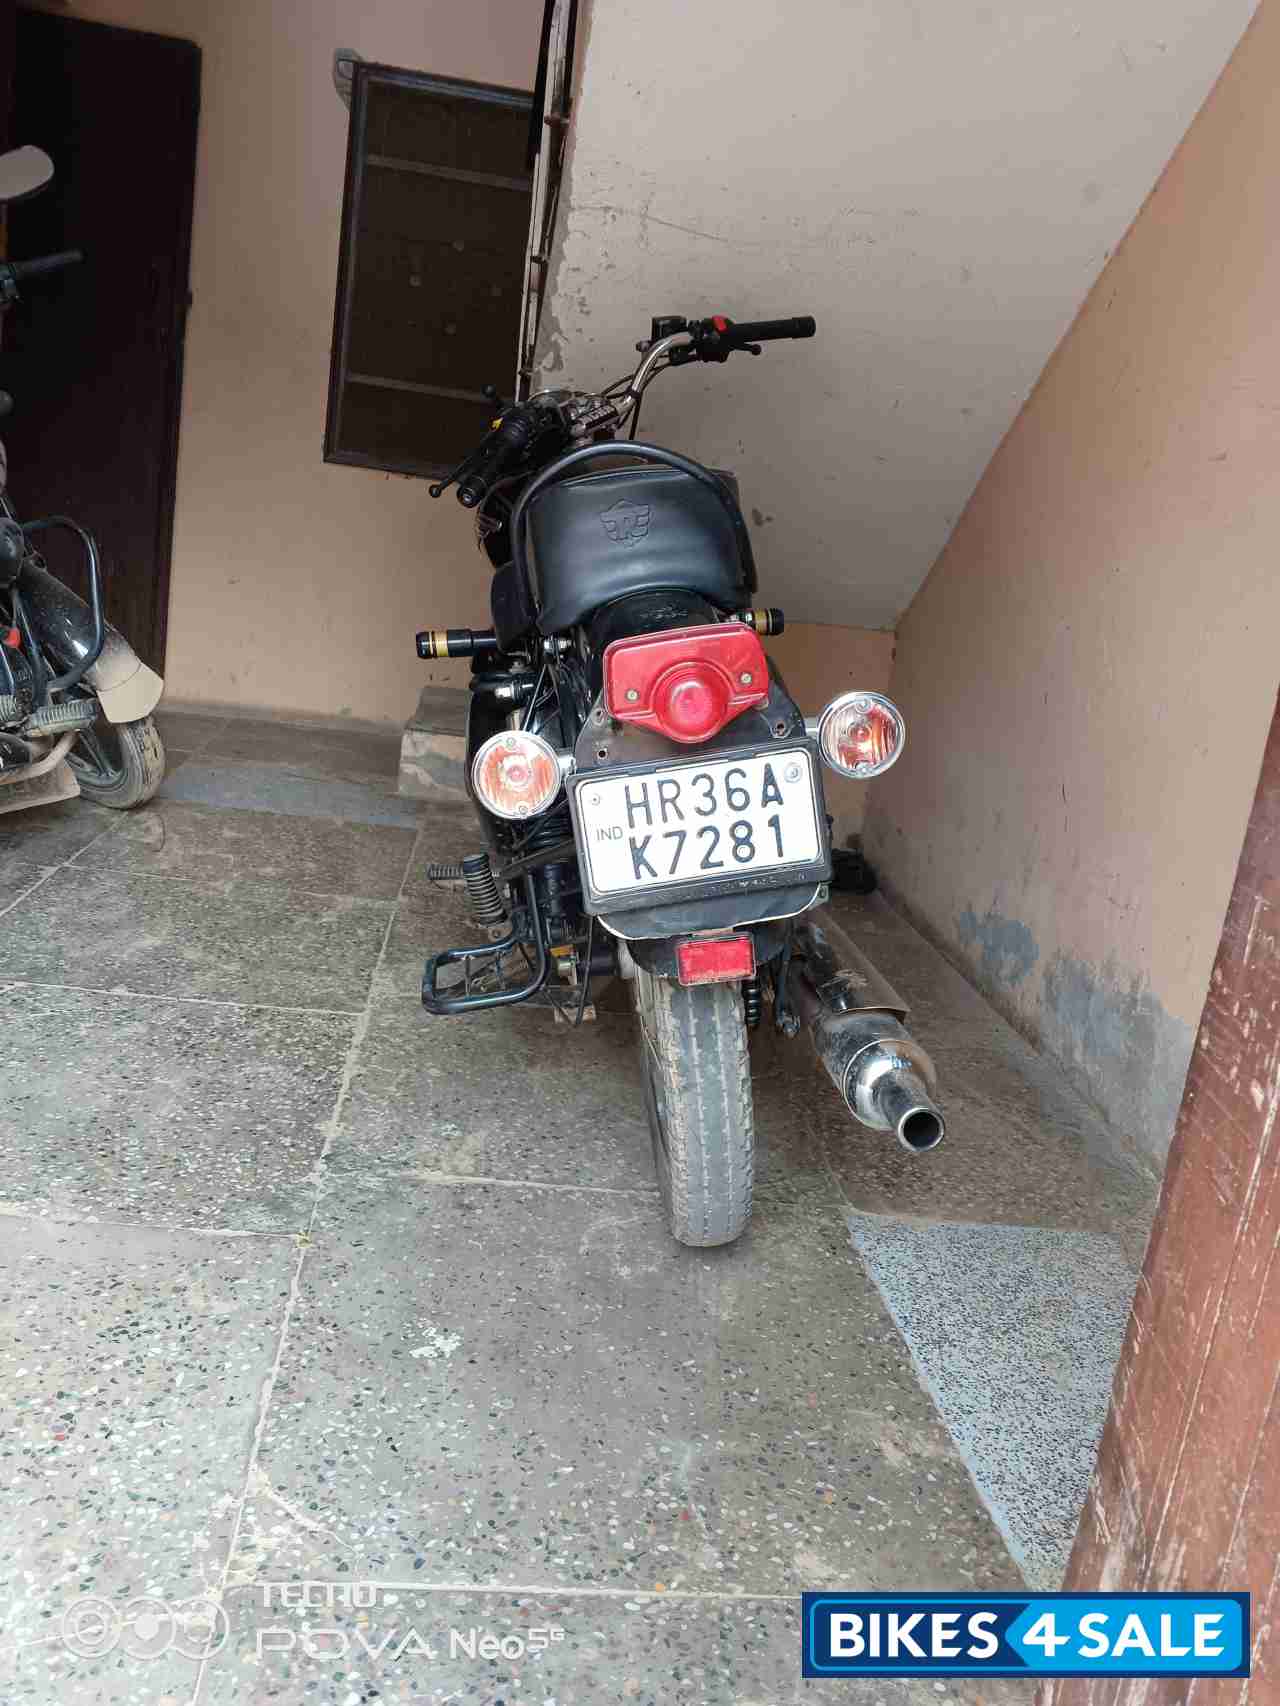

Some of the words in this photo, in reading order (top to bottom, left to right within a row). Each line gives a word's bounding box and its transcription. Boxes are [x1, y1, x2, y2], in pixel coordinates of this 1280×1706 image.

[624, 763, 784, 829] HR36A
[596, 826, 623, 841] IND
[628, 814, 784, 880] K7281
